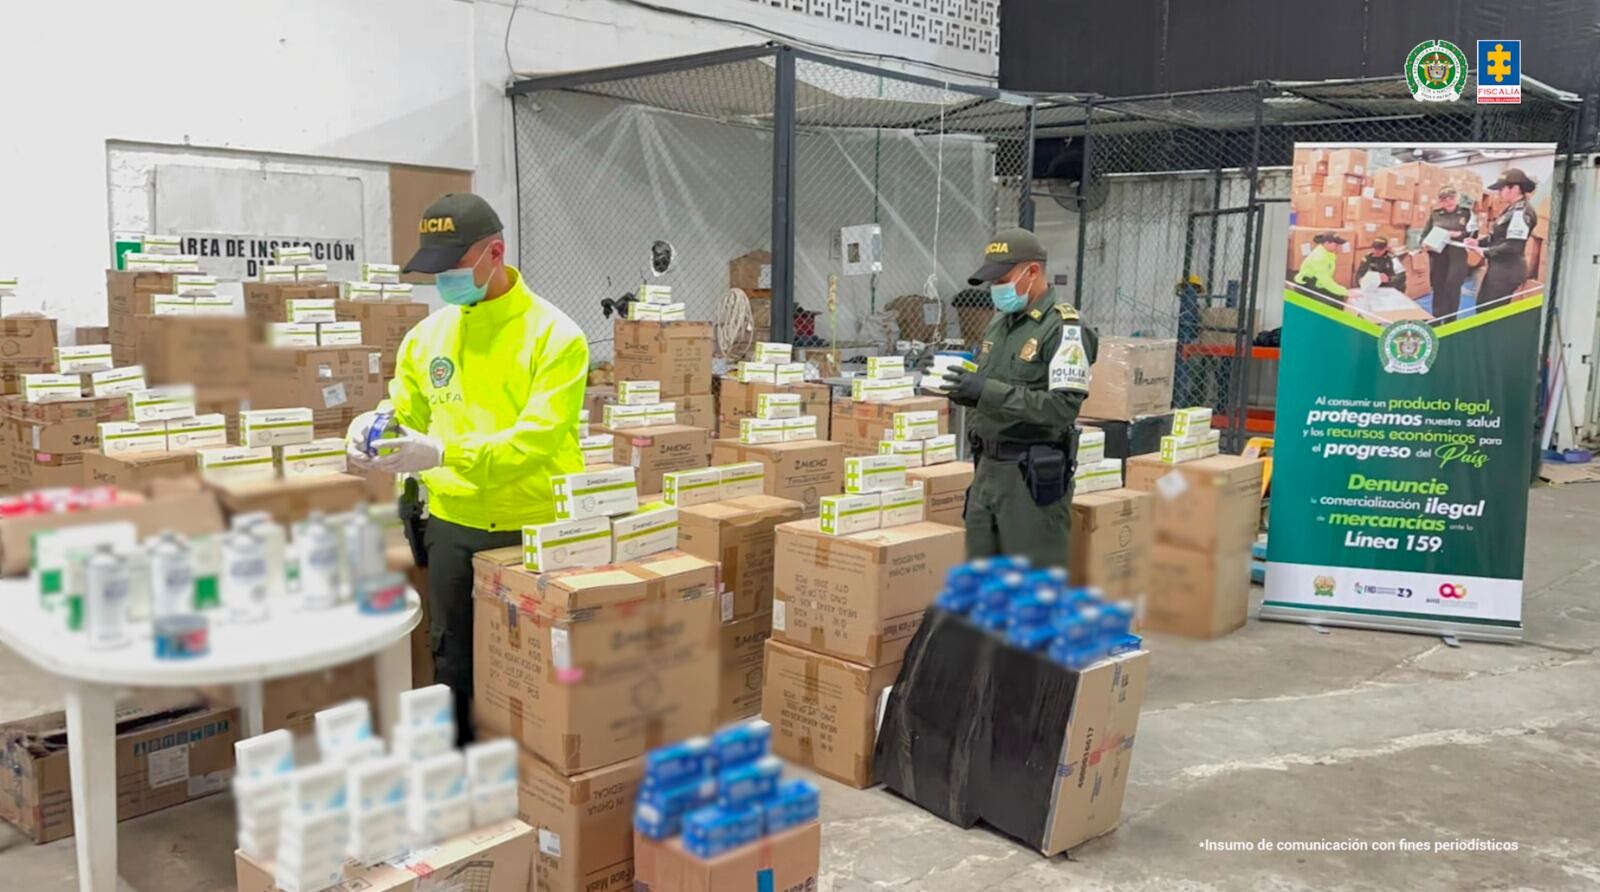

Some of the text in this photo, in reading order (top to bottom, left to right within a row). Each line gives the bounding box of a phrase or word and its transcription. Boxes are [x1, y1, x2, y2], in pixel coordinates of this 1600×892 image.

[226, 239, 245, 258] DE
[1315, 396, 1494, 415] Al consumir un producto legal,
[1306, 409, 1500, 428] protegemos nuestra salud
[1310, 427, 1325, 437] los
[1327, 427, 1385, 440] recursos
[1389, 428, 1476, 445] económicos
[1479, 435, 1502, 447] para
[1312, 443, 1322, 453] el
[1324, 442, 1412, 460] progreso
[1416, 448, 1432, 458] del
[1348, 473, 1449, 495] Denuncie
[1320, 495, 1421, 511] comercialización
[1425, 497, 1485, 520] ilegal
[1329, 513, 1446, 532] mercancías
[1345, 530, 1400, 550] Línea
